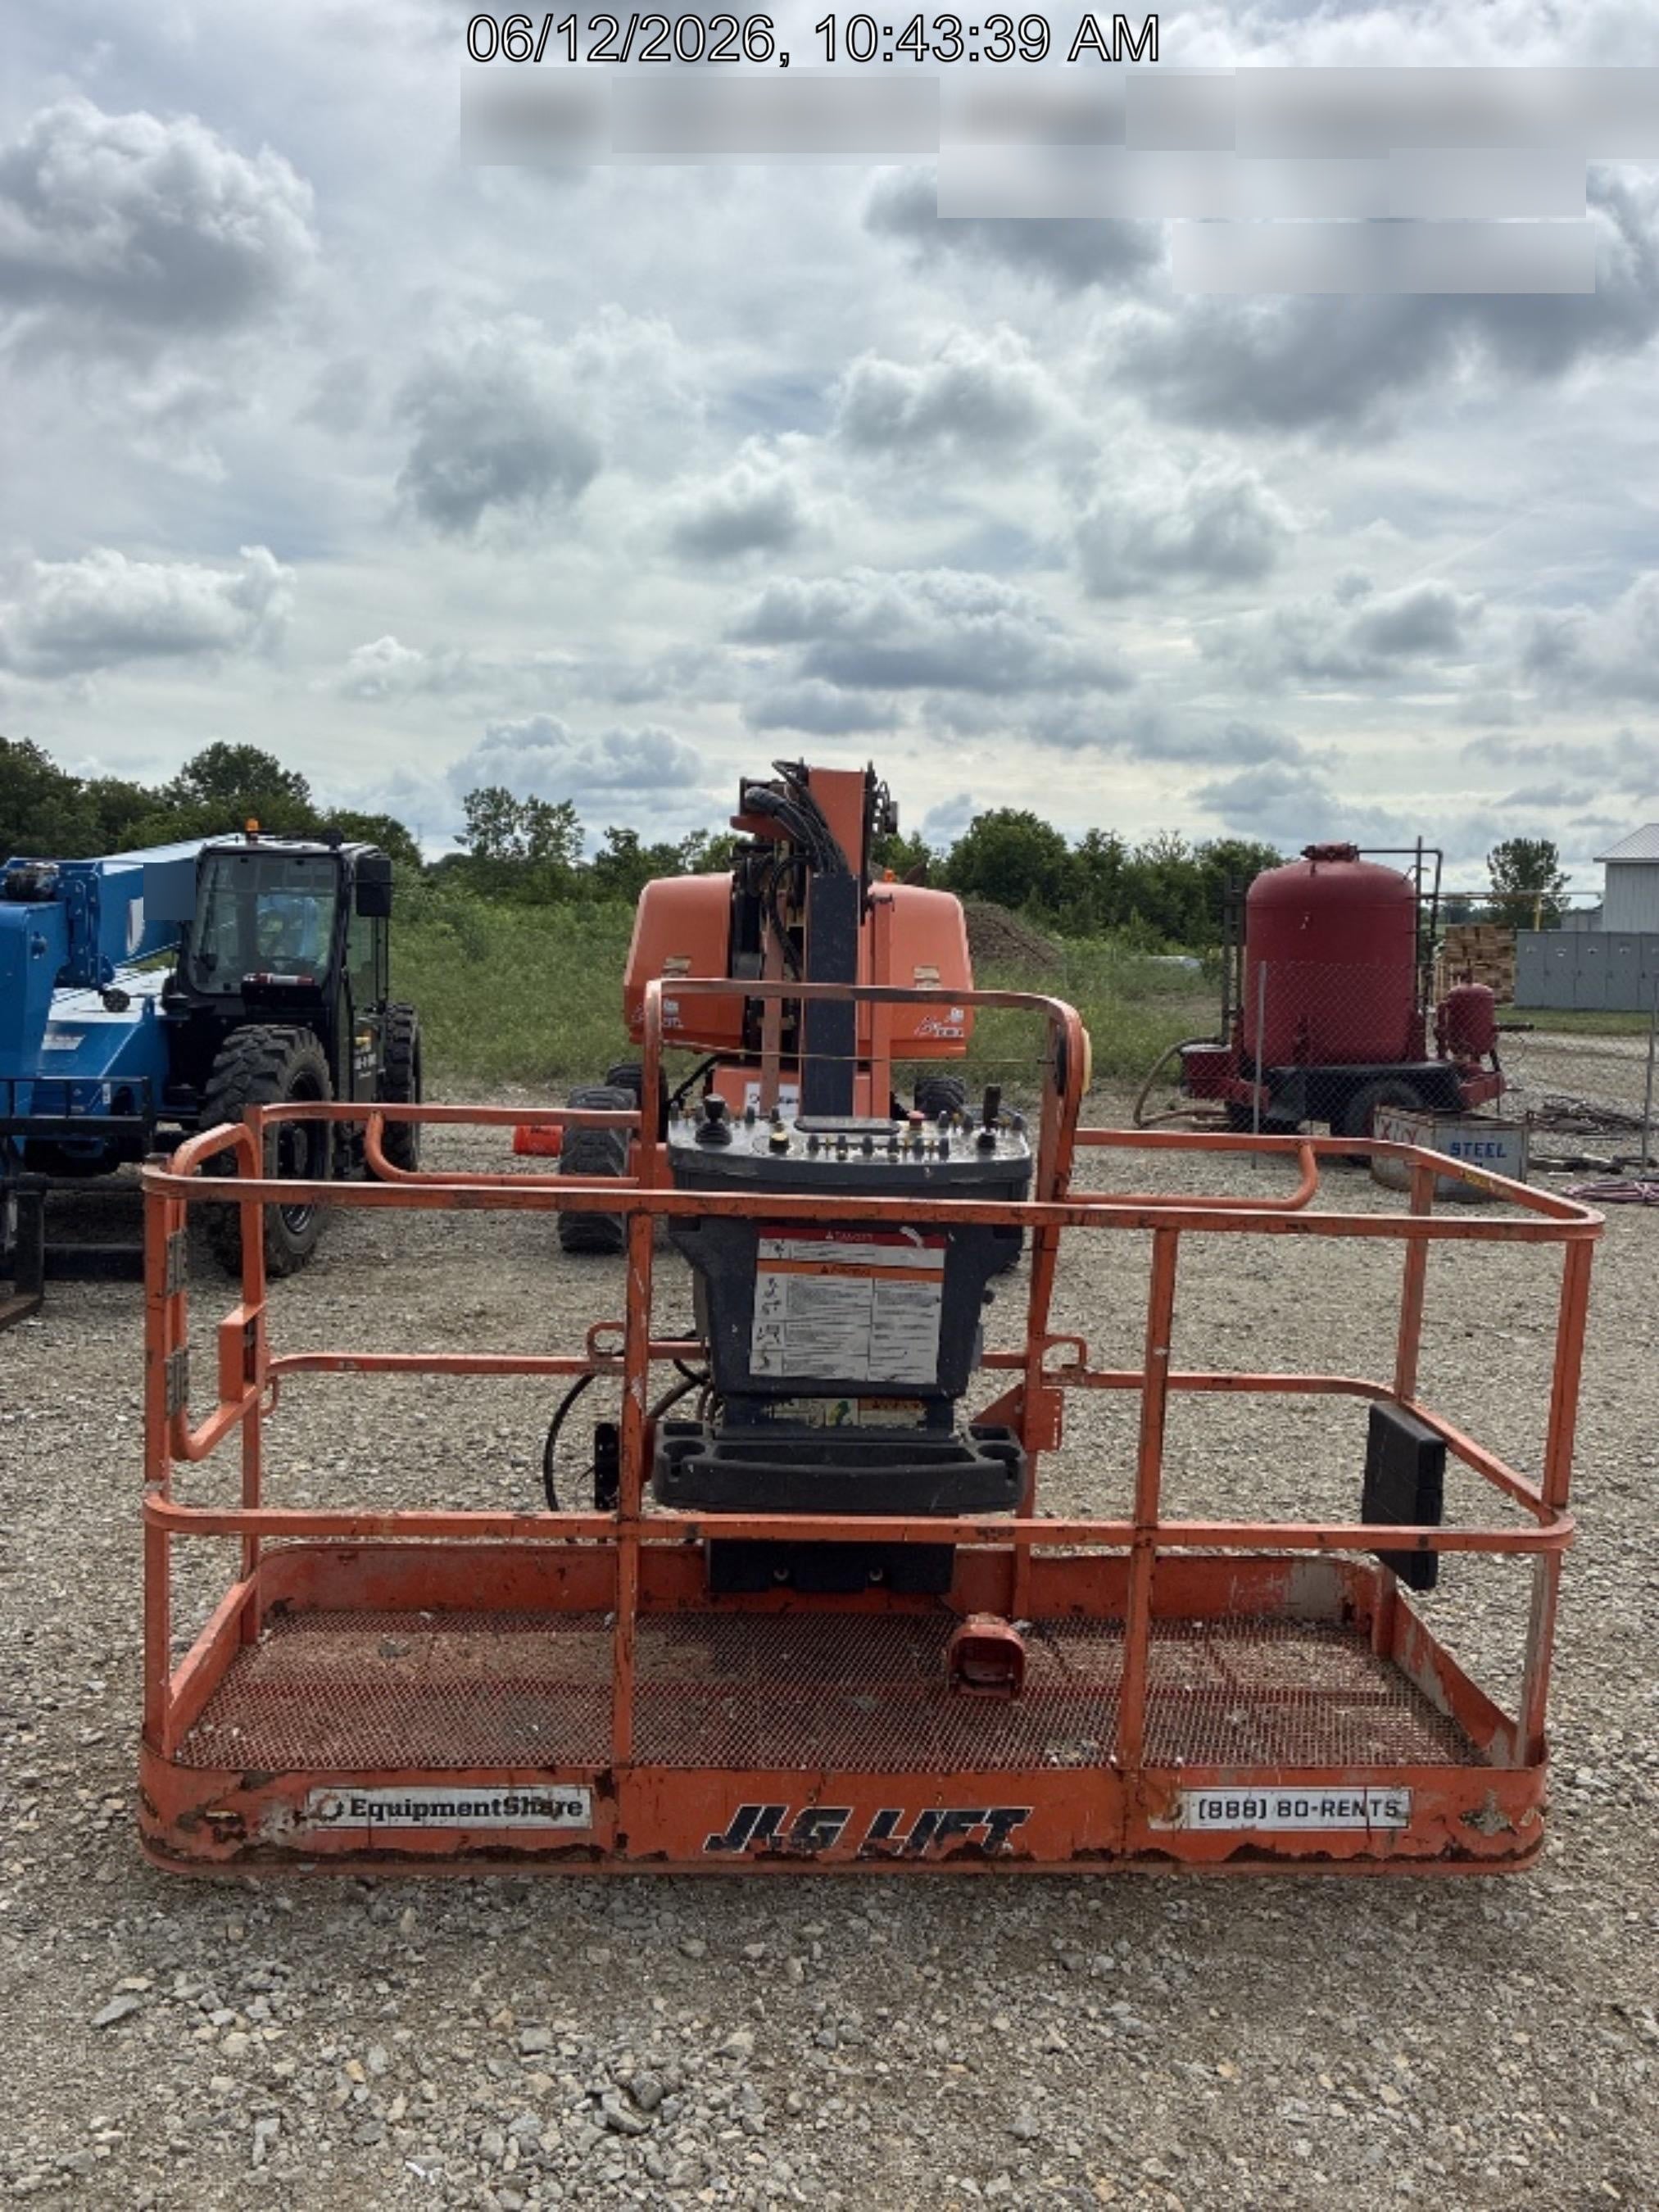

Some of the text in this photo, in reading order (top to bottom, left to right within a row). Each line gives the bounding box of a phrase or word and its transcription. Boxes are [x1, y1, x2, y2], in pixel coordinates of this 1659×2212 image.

[1449, 1142, 1507, 1158] STEEL
[349, 1795, 583, 1821] EquipmentShare
[1198, 1798, 1400, 1820] (888) 80-RENTS
[857, 1806, 1035, 1856] LIFT
